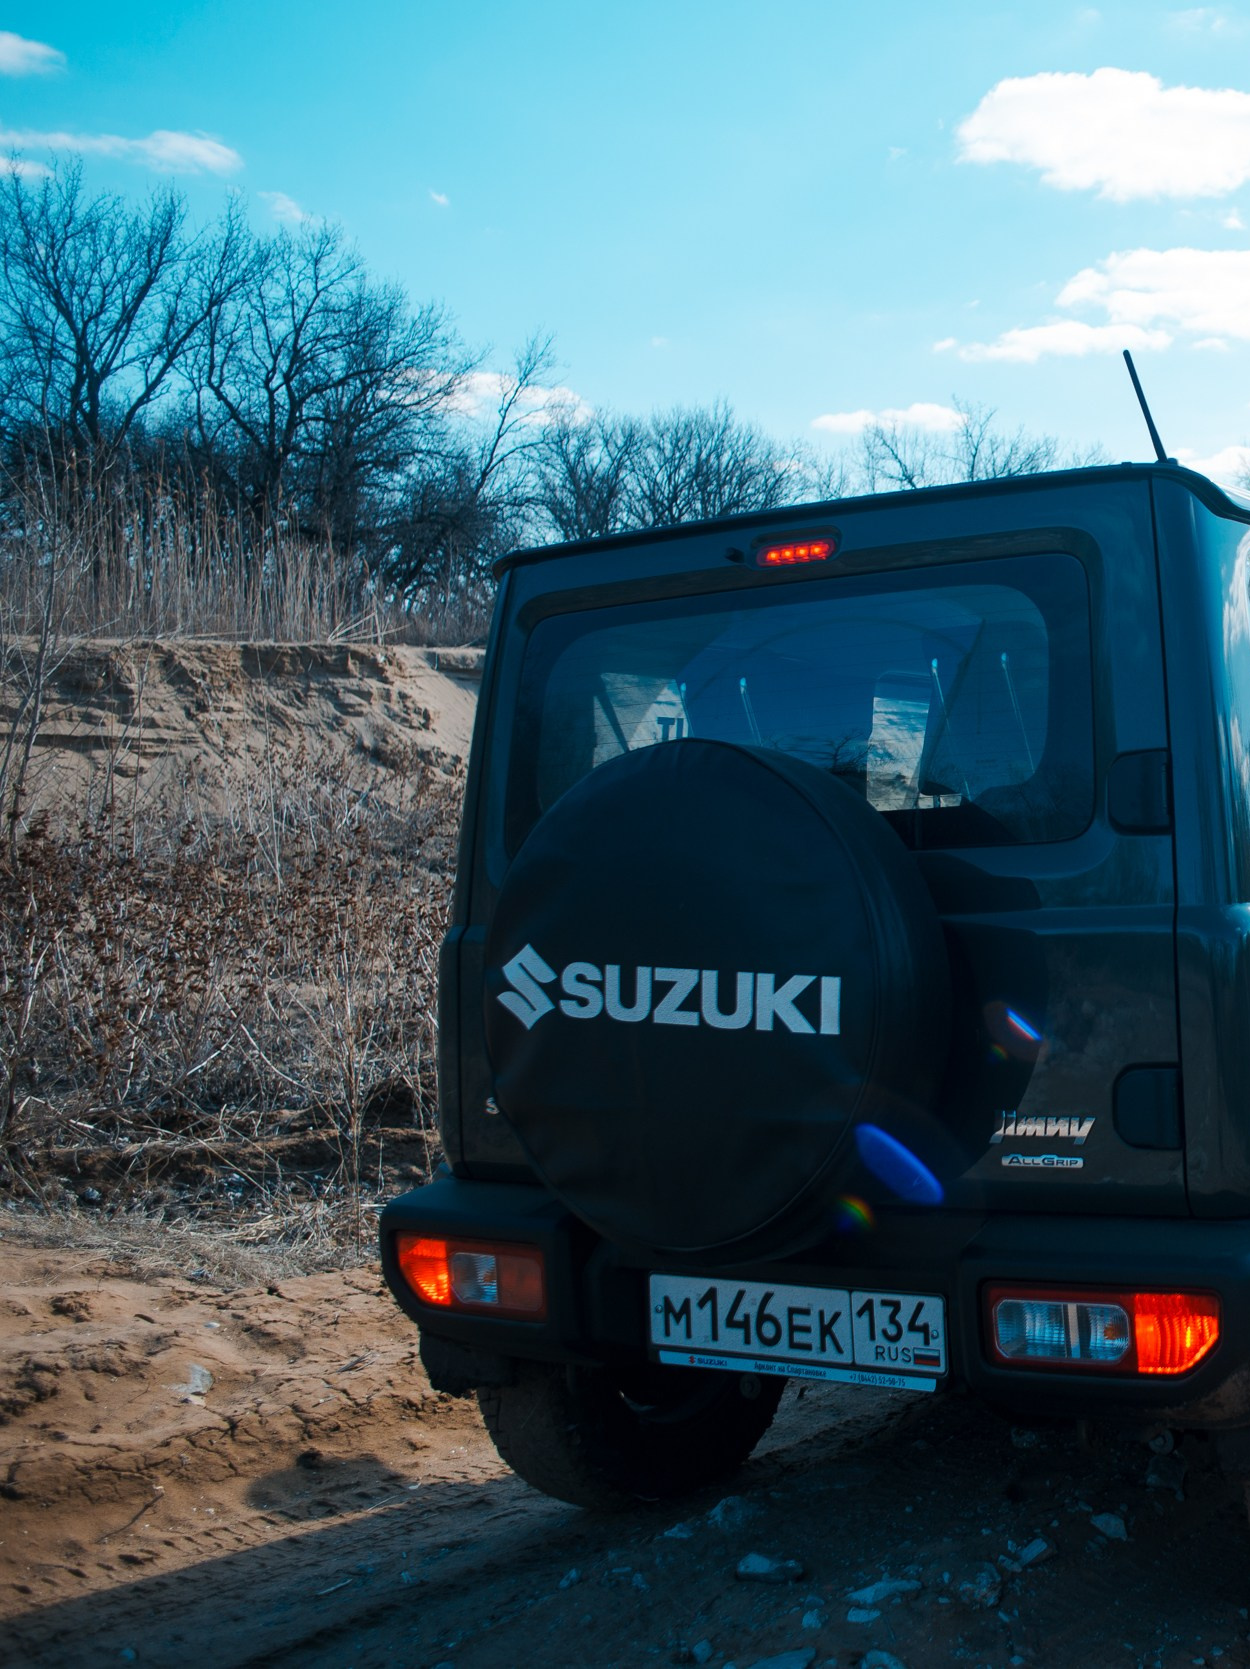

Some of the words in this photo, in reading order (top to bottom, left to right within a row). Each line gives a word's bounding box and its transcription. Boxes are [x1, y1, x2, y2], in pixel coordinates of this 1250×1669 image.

[559, 961, 841, 1035] SUZUKI
[856, 1298, 931, 1346] 134
[697, 1357, 728, 1367] SUZUKI
[874, 1345, 912, 1363] RUS
